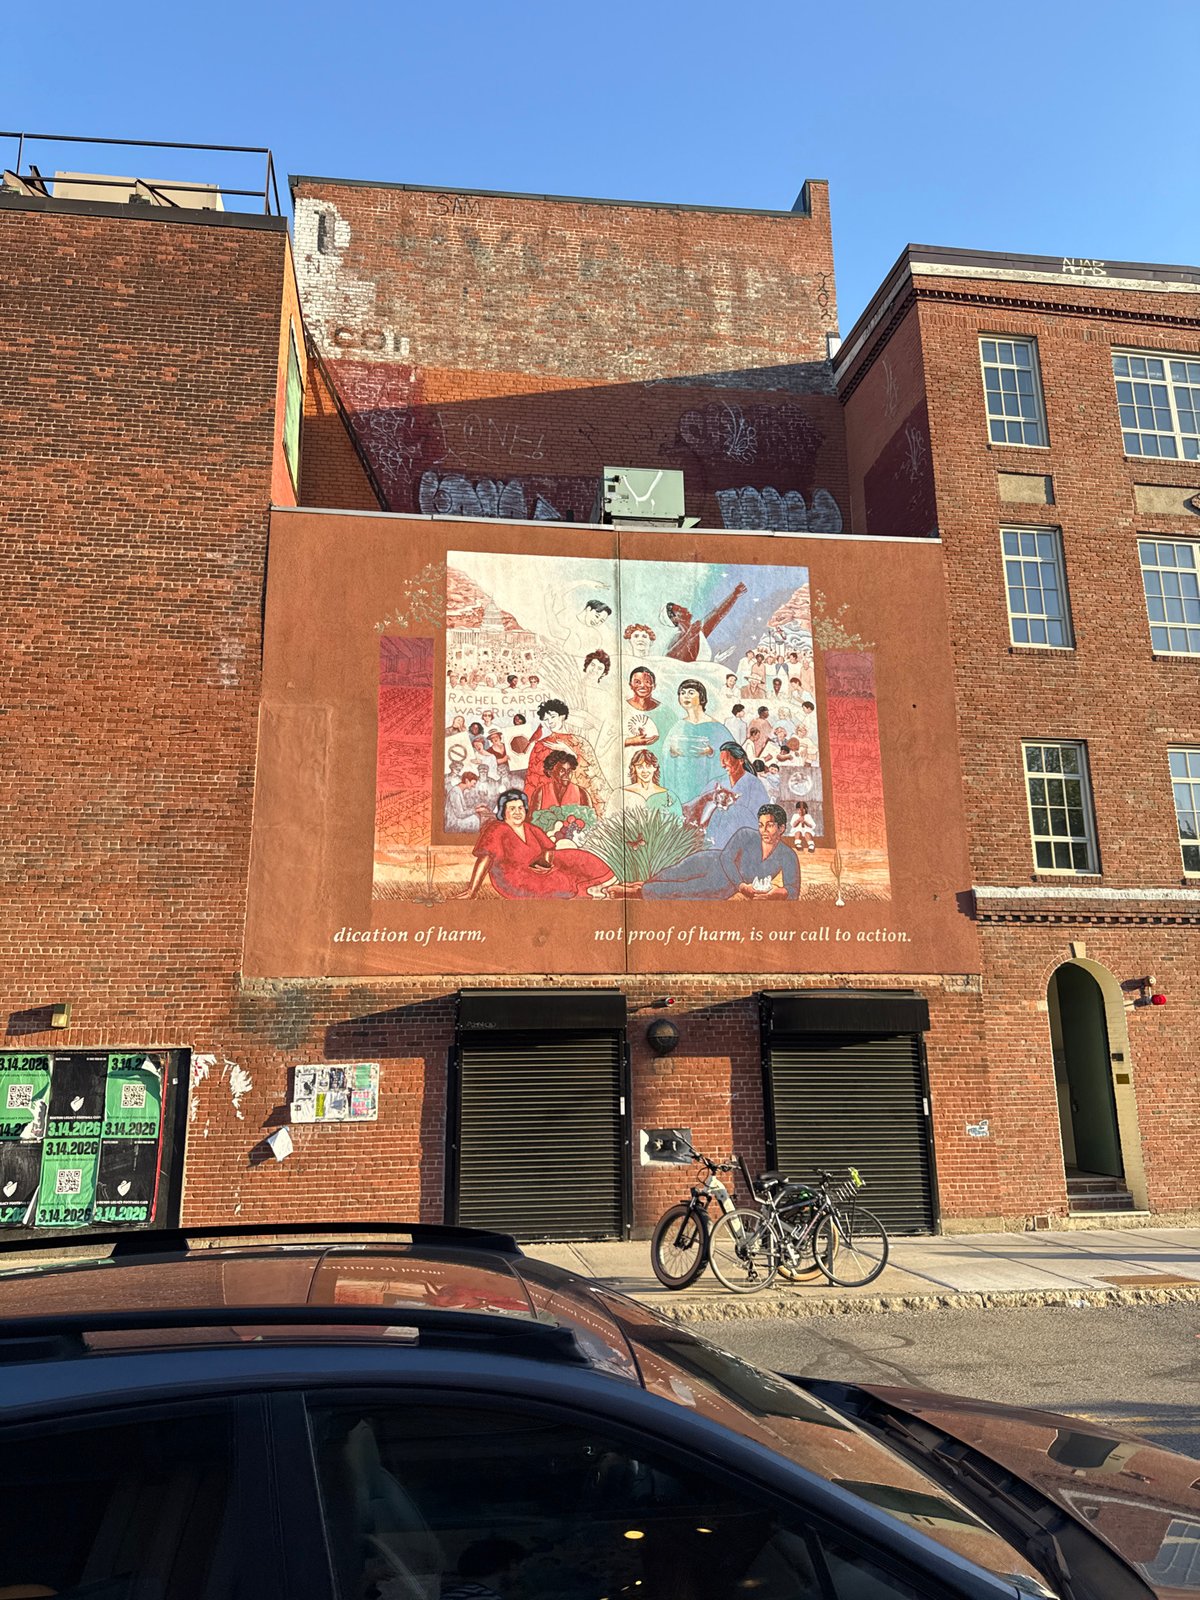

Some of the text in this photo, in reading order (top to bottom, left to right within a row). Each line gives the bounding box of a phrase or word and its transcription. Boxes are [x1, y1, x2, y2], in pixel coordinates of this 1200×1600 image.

[433, 195, 480, 216] SAM
[449, 691, 551, 705] RACHEL CARSON
[454, 707, 537, 718] WAS RIGHT
[333, 926, 487, 947] dication of harm,
[594, 926, 912, 945] not proof of harm, is our call to action.
[111, 1058, 144, 1071] 3.14.2
[48, 1121, 101, 1136] 3.14.2026
[105, 1121, 156, 1136] 3.14.2026
[46, 1142, 98, 1156] 3.14.2026
[39, 1208, 92, 1222] 3.14.2026
[94, 1206, 147, 1221] 3.14.2026
